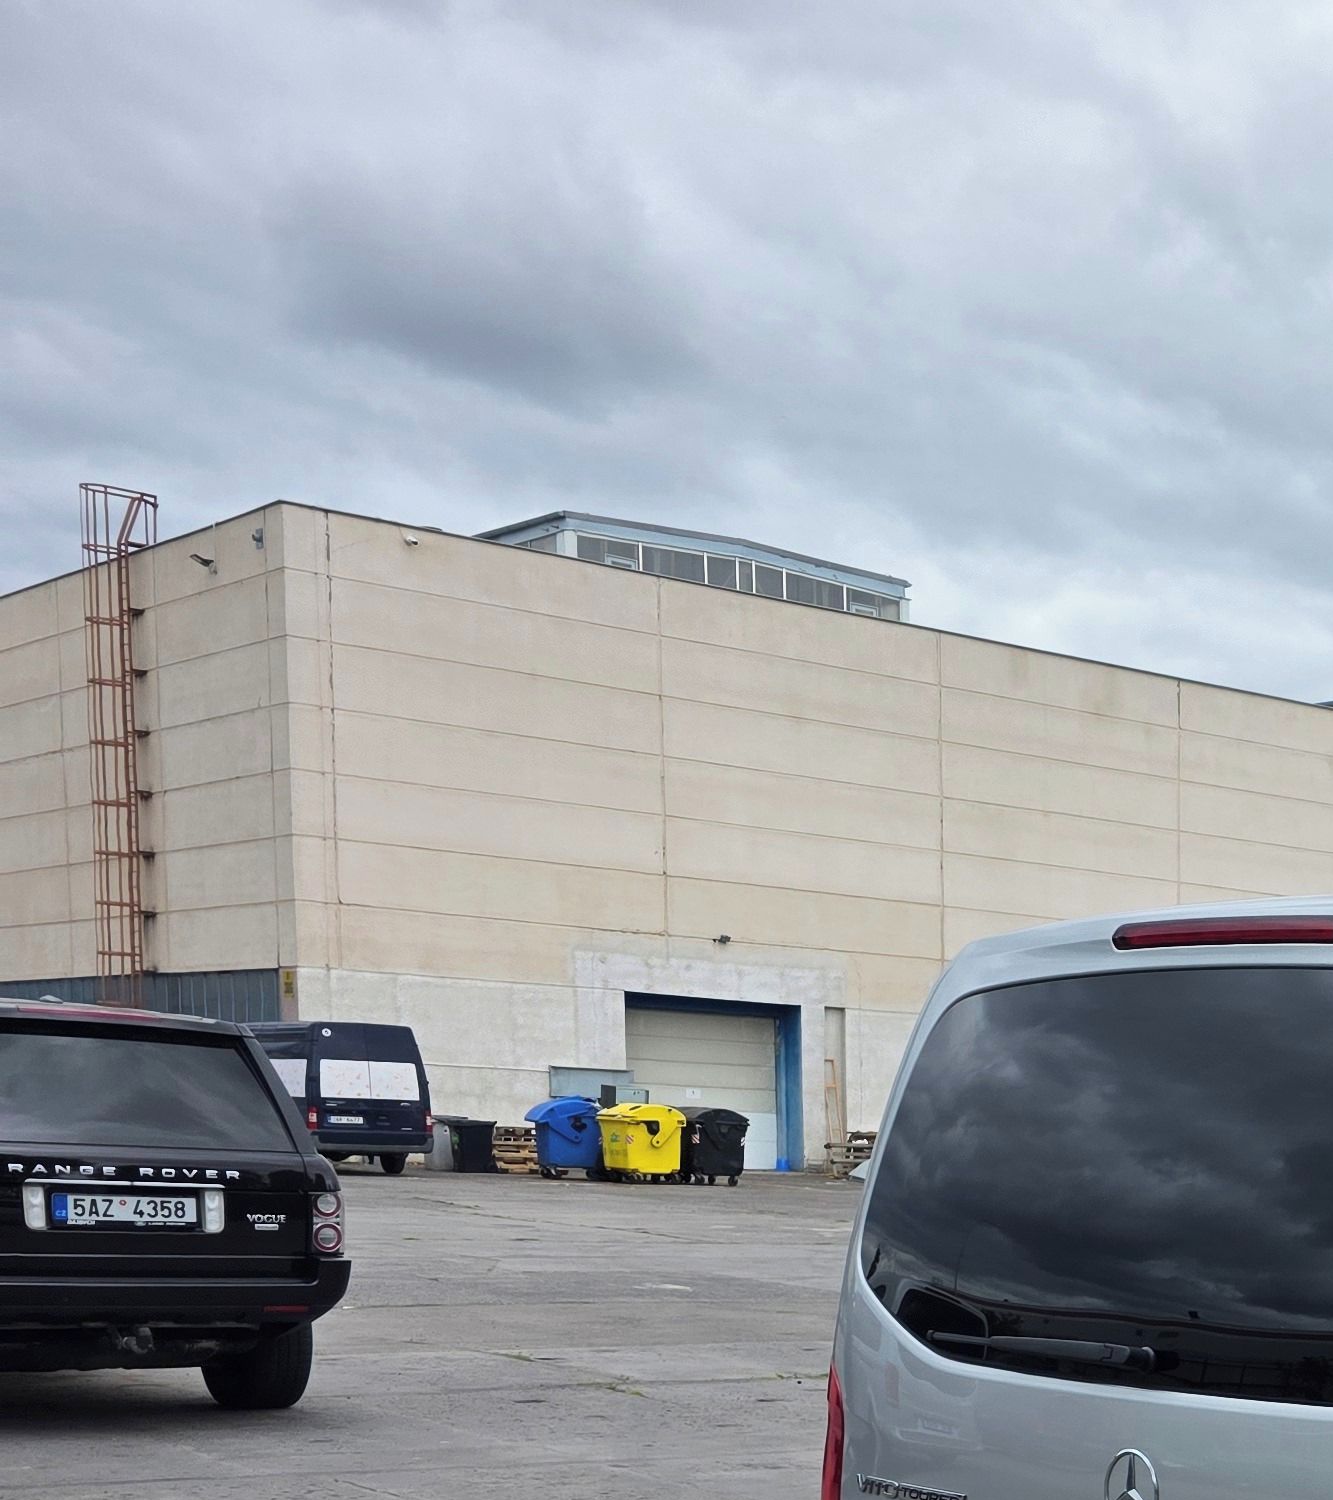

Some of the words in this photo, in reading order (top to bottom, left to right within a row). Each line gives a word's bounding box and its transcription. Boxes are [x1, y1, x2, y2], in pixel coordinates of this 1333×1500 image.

[8, 1163, 117, 1176] RANGE
[139, 1167, 241, 1180] ROVER
[73, 1198, 114, 1218] 5AZ
[133, 1199, 186, 1219] 4358
[247, 1213, 287, 1223] VOGUE
